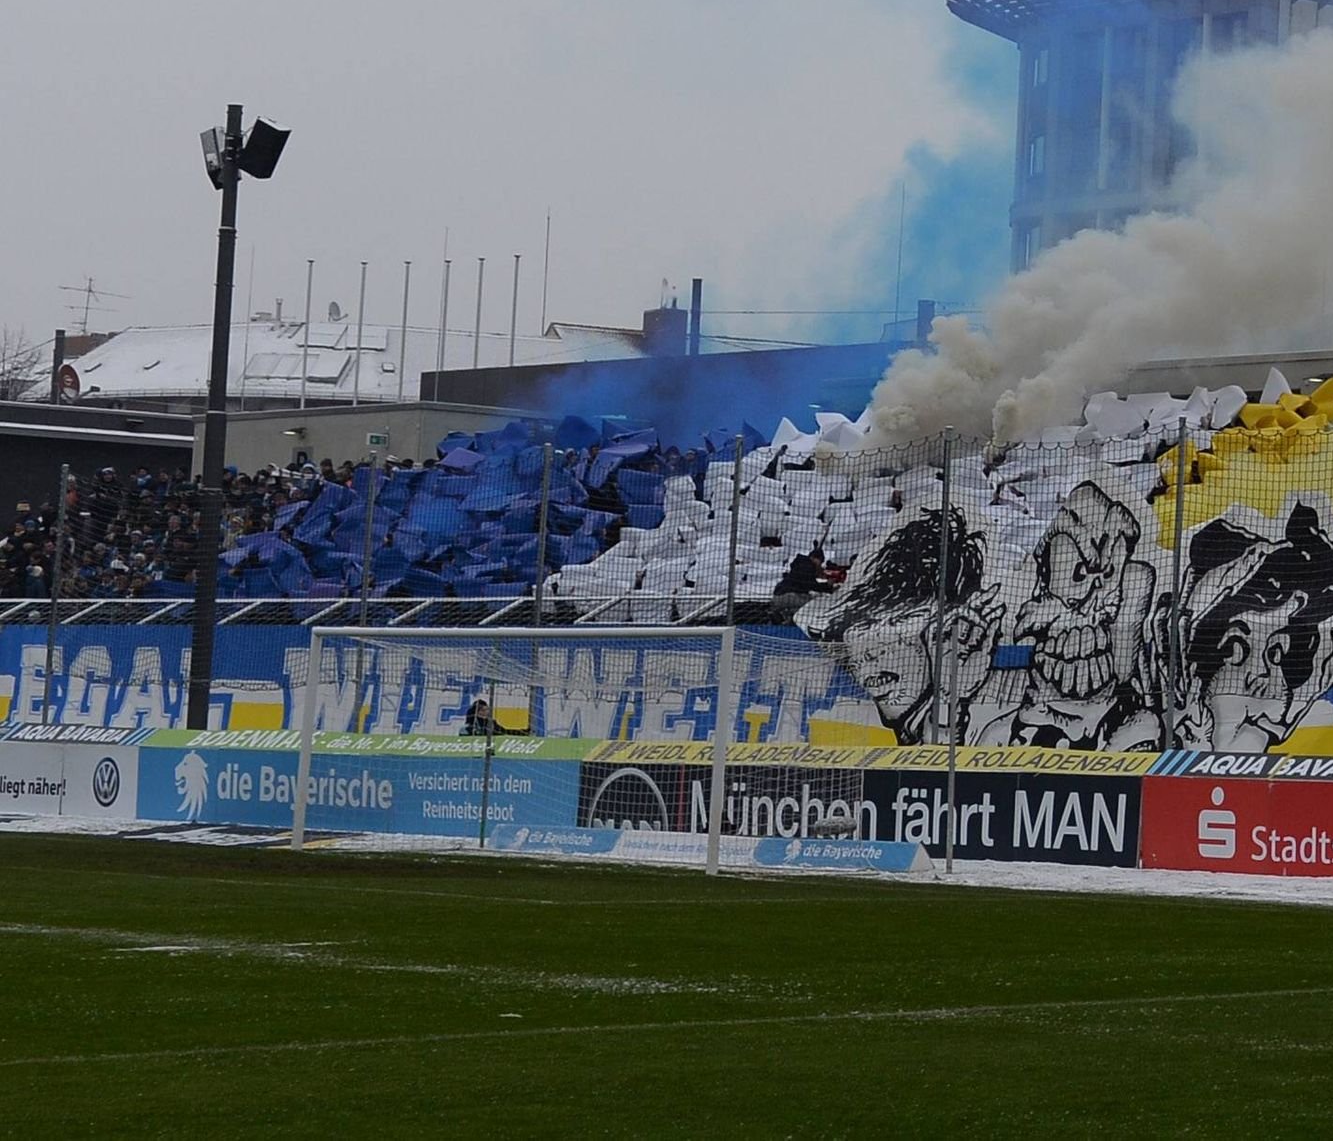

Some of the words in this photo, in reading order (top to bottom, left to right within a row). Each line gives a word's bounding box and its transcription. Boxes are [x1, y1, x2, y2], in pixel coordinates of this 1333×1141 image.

[284, 647, 482, 734] WIE
[12, 725, 59, 741] AQUA
[58, 726, 129, 742] BAVARIA
[327, 736, 352, 749] die
[407, 737, 495, 754] Bayerische
[498, 739, 544, 753] Wald
[628, 745, 692, 760] WEIDL
[890, 749, 962, 767] WEIDL
[965, 750, 1149, 773] ROLLADENBAU
[1189, 755, 1263, 775] AQUA
[28, 777, 66, 796] näher!
[217, 763, 252, 801] die
[259, 765, 393, 810] Bayerische
[408, 772, 469, 792] Versichert
[474, 774, 501, 794] nach
[504, 775, 531, 794] dem
[690, 780, 878, 841] München
[892, 788, 996, 847] fährt
[1012, 790, 1127, 853] MAN
[803, 844, 821, 857] die
[822, 844, 883, 860] Bayerische
